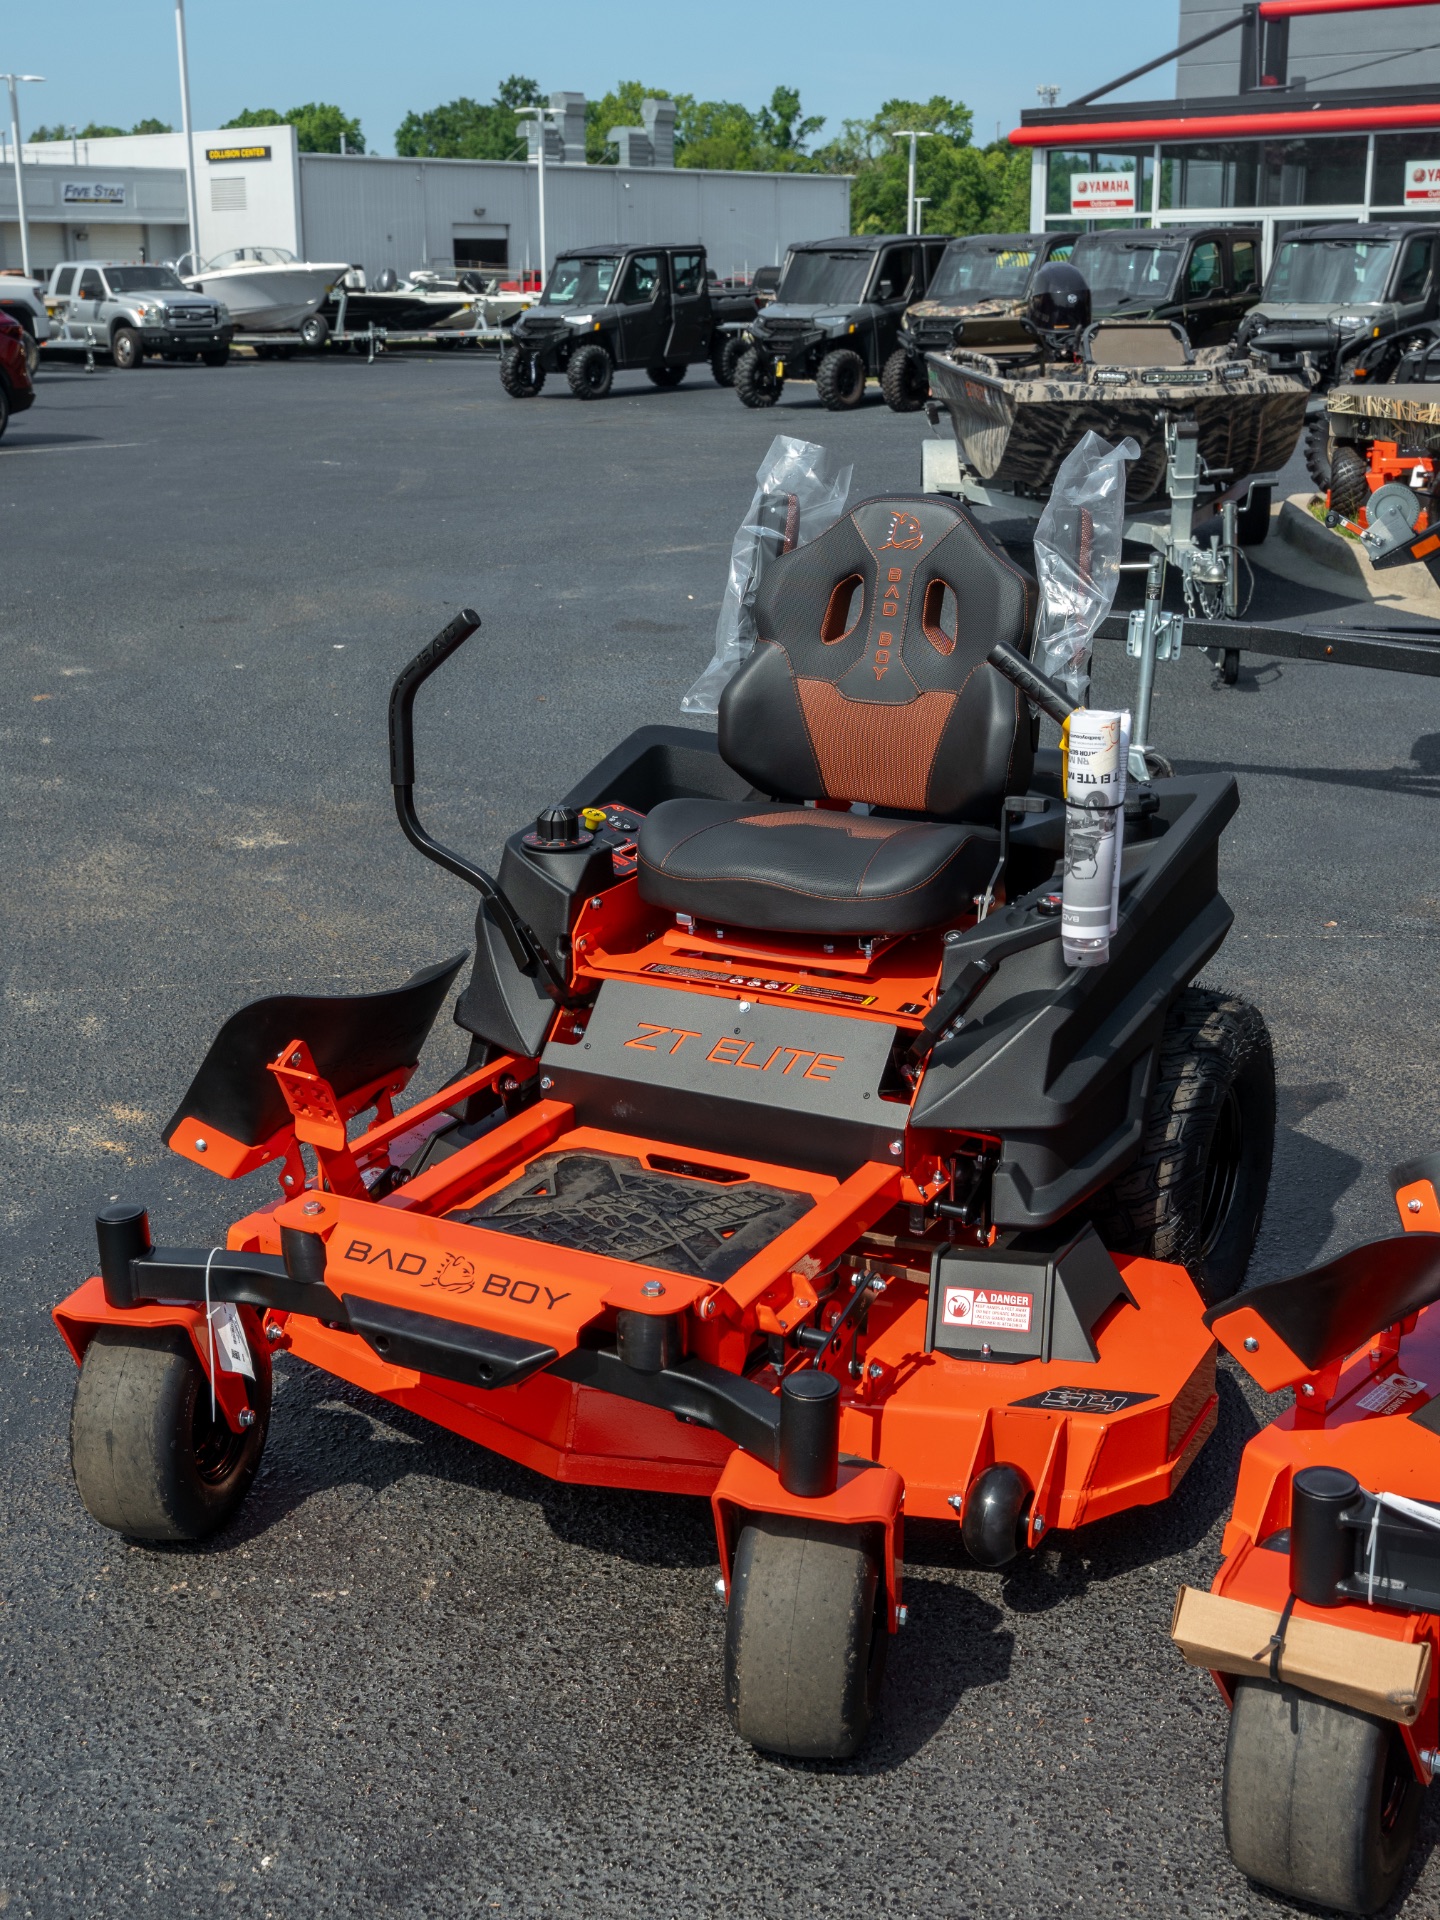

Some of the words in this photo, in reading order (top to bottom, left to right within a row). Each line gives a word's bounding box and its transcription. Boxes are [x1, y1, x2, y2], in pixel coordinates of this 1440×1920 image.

[208, 149, 241, 160] COLLISION
[241, 147, 266, 158] CENTER
[1089, 180, 1130, 194] YAMAHA
[623, 1022, 702, 1055] ZT
[705, 1036, 845, 1082] ELITE
[344, 1239, 427, 1276] BAD
[482, 1273, 572, 1310] BOY
[990, 1293, 1029, 1305] DANGER
